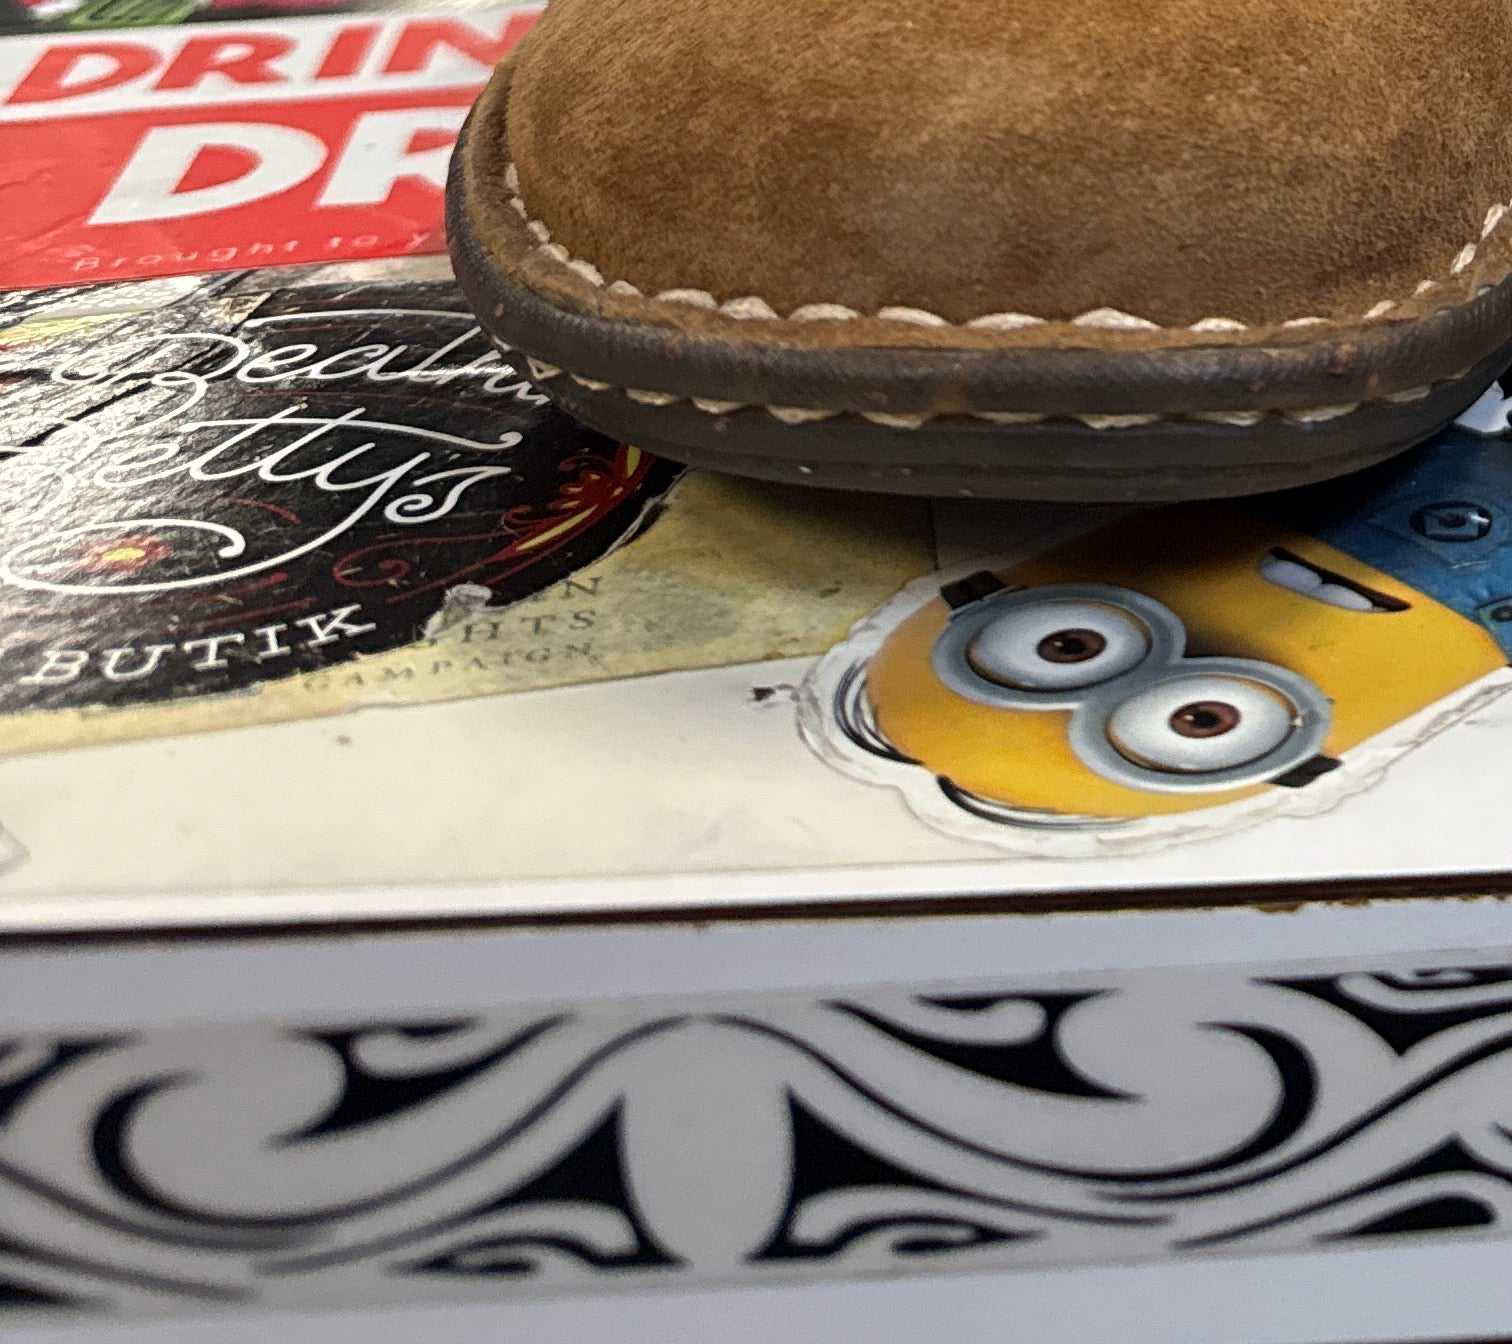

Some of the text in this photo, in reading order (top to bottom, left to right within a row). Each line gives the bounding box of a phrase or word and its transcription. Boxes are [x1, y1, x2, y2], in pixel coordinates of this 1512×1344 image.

[3, 10, 541, 106] DRIN
[87, 107, 474, 226] DR
[19, 603, 377, 686] BUTIK
